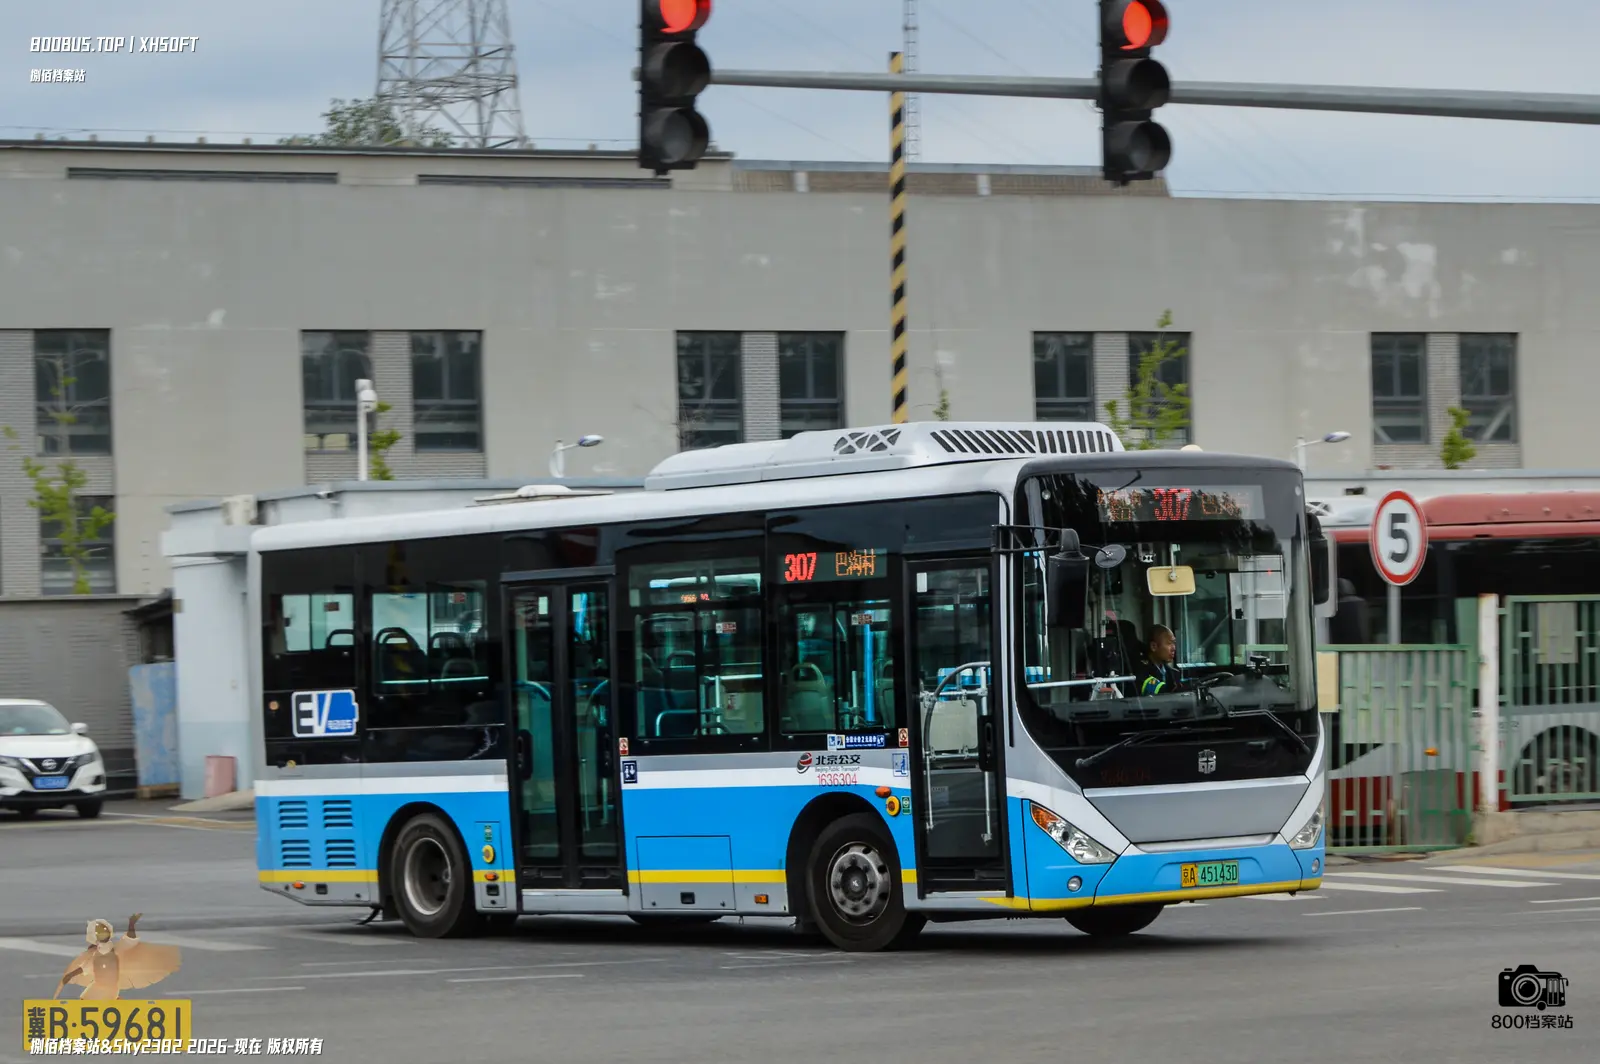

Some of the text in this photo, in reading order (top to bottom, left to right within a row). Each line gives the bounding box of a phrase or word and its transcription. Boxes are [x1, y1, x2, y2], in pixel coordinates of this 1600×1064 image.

[1153, 487, 1193, 521] 307
[1388, 512, 1411, 564] 5
[784, 548, 877, 582] 307 巴沟村
[295, 692, 332, 735] EV
[815, 754, 861, 766] 北京公交
[816, 772, 858, 787] 1636304
